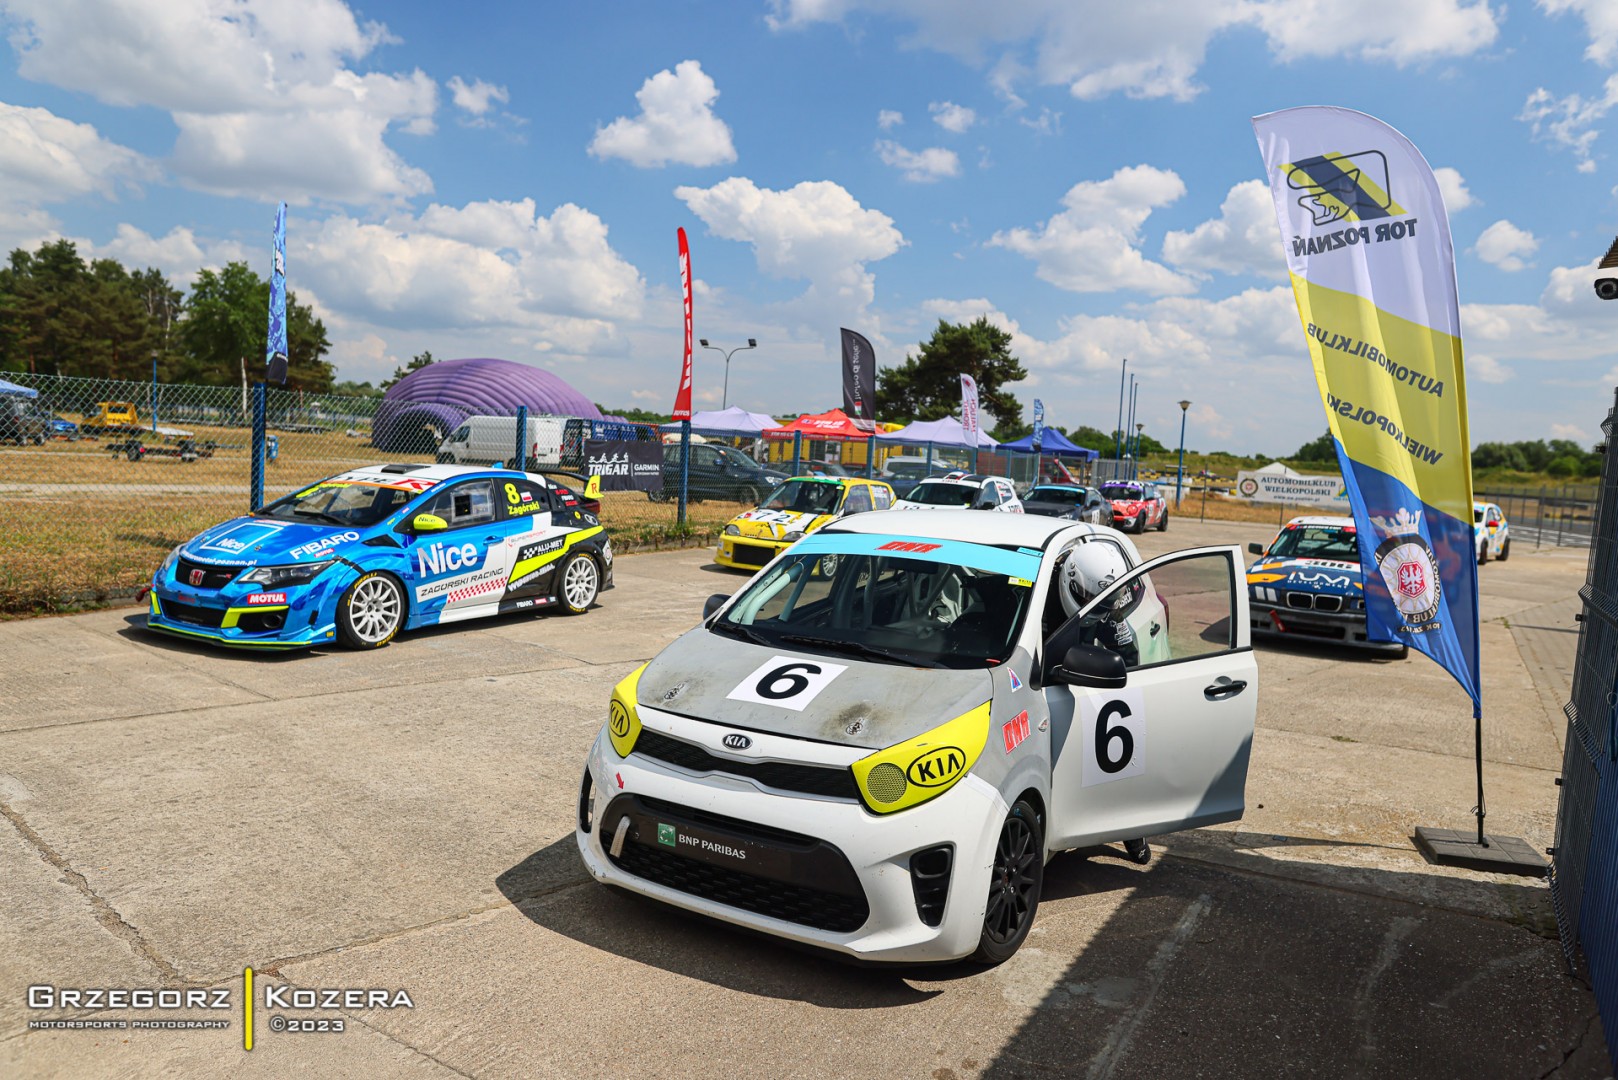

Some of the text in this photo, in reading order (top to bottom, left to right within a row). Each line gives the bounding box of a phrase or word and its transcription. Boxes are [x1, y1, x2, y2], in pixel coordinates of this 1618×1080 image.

[588, 463, 629, 476] TRIGAR
[634, 463, 660, 471] GARMIN
[1261, 476, 1337, 488] AUTOMOBILKLUB
[504, 482, 521, 504] 8
[1264, 485, 1331, 496] WIELKOPOLSKI
[507, 501, 540, 516] Zagórski
[215, 537, 246, 550] Nice
[289, 531, 360, 560] FIBARO
[537, 539, 564, 552] ALU-MET
[416, 541, 479, 579] Nice
[470, 566, 504, 584] RACING
[249, 593, 286, 604] MOTUL
[755, 663, 823, 700] 6
[610, 701, 625, 731] KIA
[725, 734, 747, 748] KIA
[1094, 699, 1134, 775] 6
[917, 752, 962, 783] KIA
[678, 833, 747, 860] BNP PARIBAS
